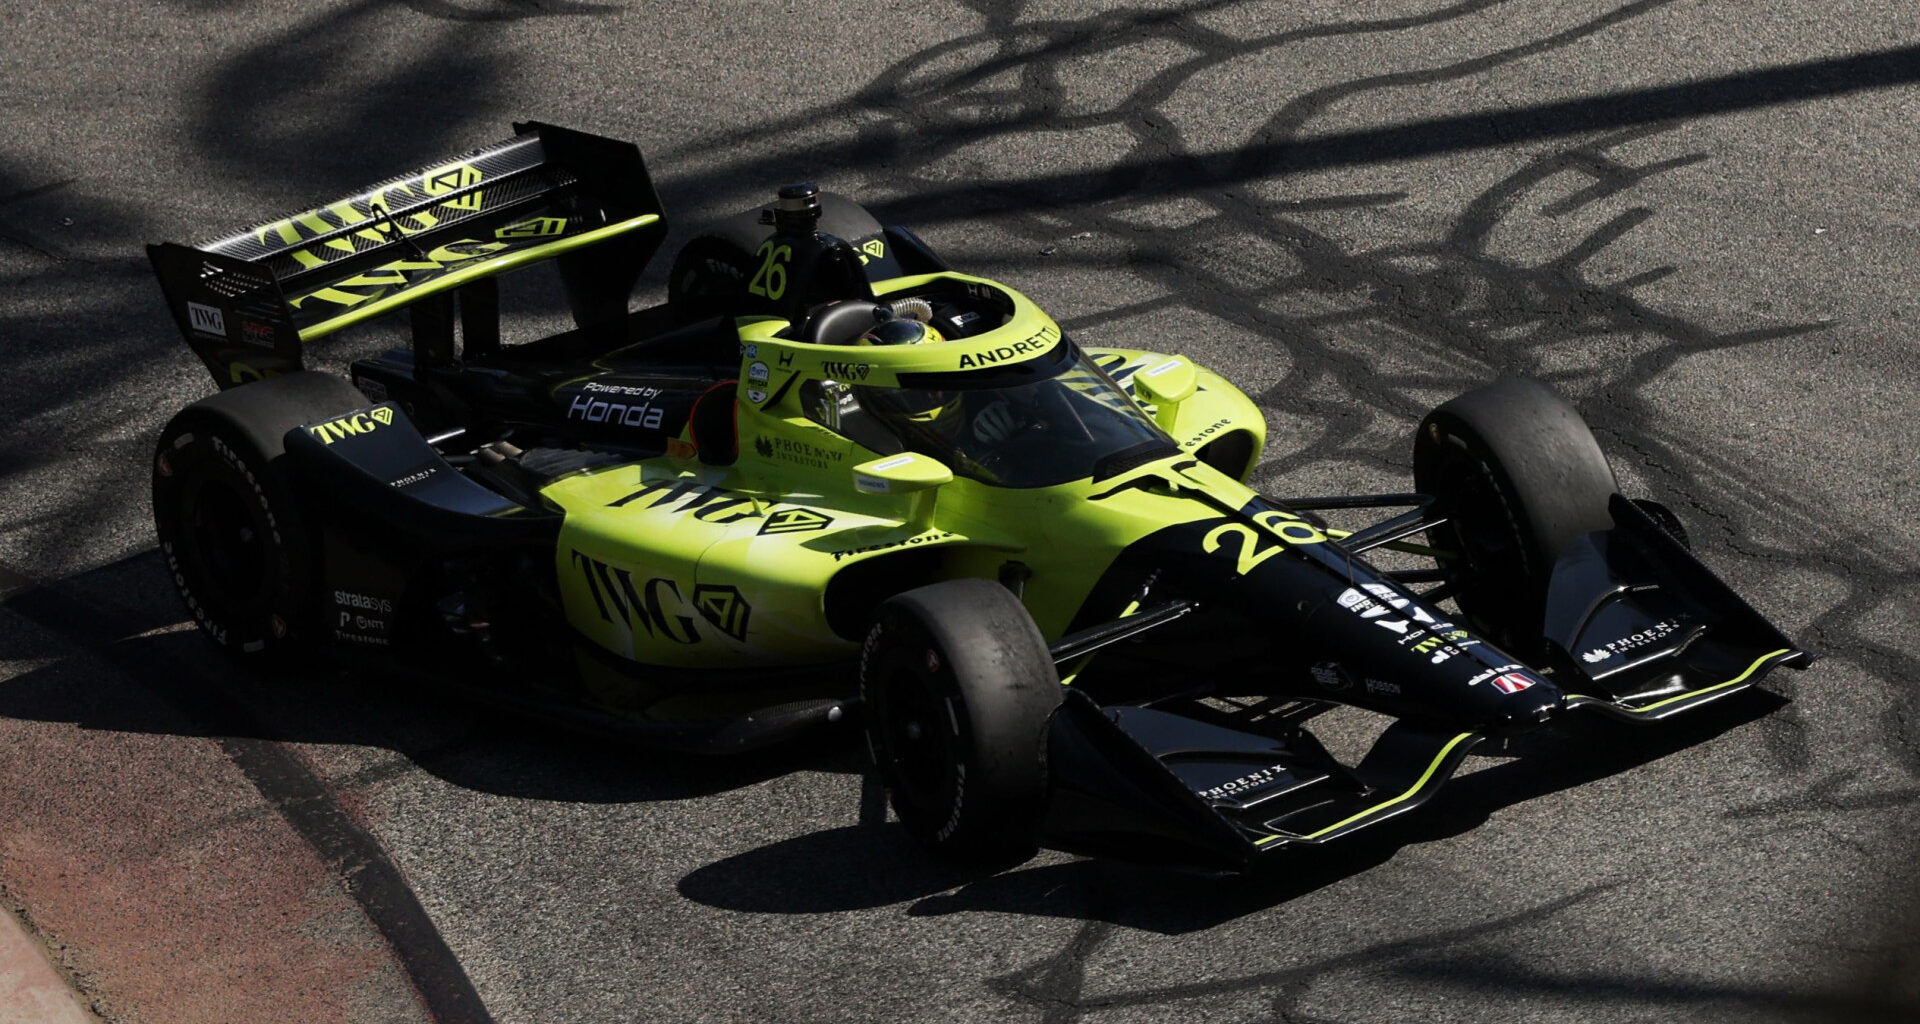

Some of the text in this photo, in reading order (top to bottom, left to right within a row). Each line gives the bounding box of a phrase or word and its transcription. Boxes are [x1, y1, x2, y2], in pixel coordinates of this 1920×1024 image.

[749, 239, 792, 301] 26
[191, 307, 222, 331] TWG
[820, 361, 858, 381] TWG
[583, 381, 664, 400] Powered by
[310, 412, 377, 445] TWG
[567, 394, 665, 430] Honda
[1185, 417, 1232, 447] estone
[604, 479, 779, 525] TWG
[830, 530, 955, 562] Firestone
[1203, 510, 1328, 576] 26
[334, 590, 394, 615] stratasys
[571, 548, 702, 645] TWG
[1605, 611, 1692, 652] PHOENIX
[1198, 763, 1288, 798] PHOENIX
